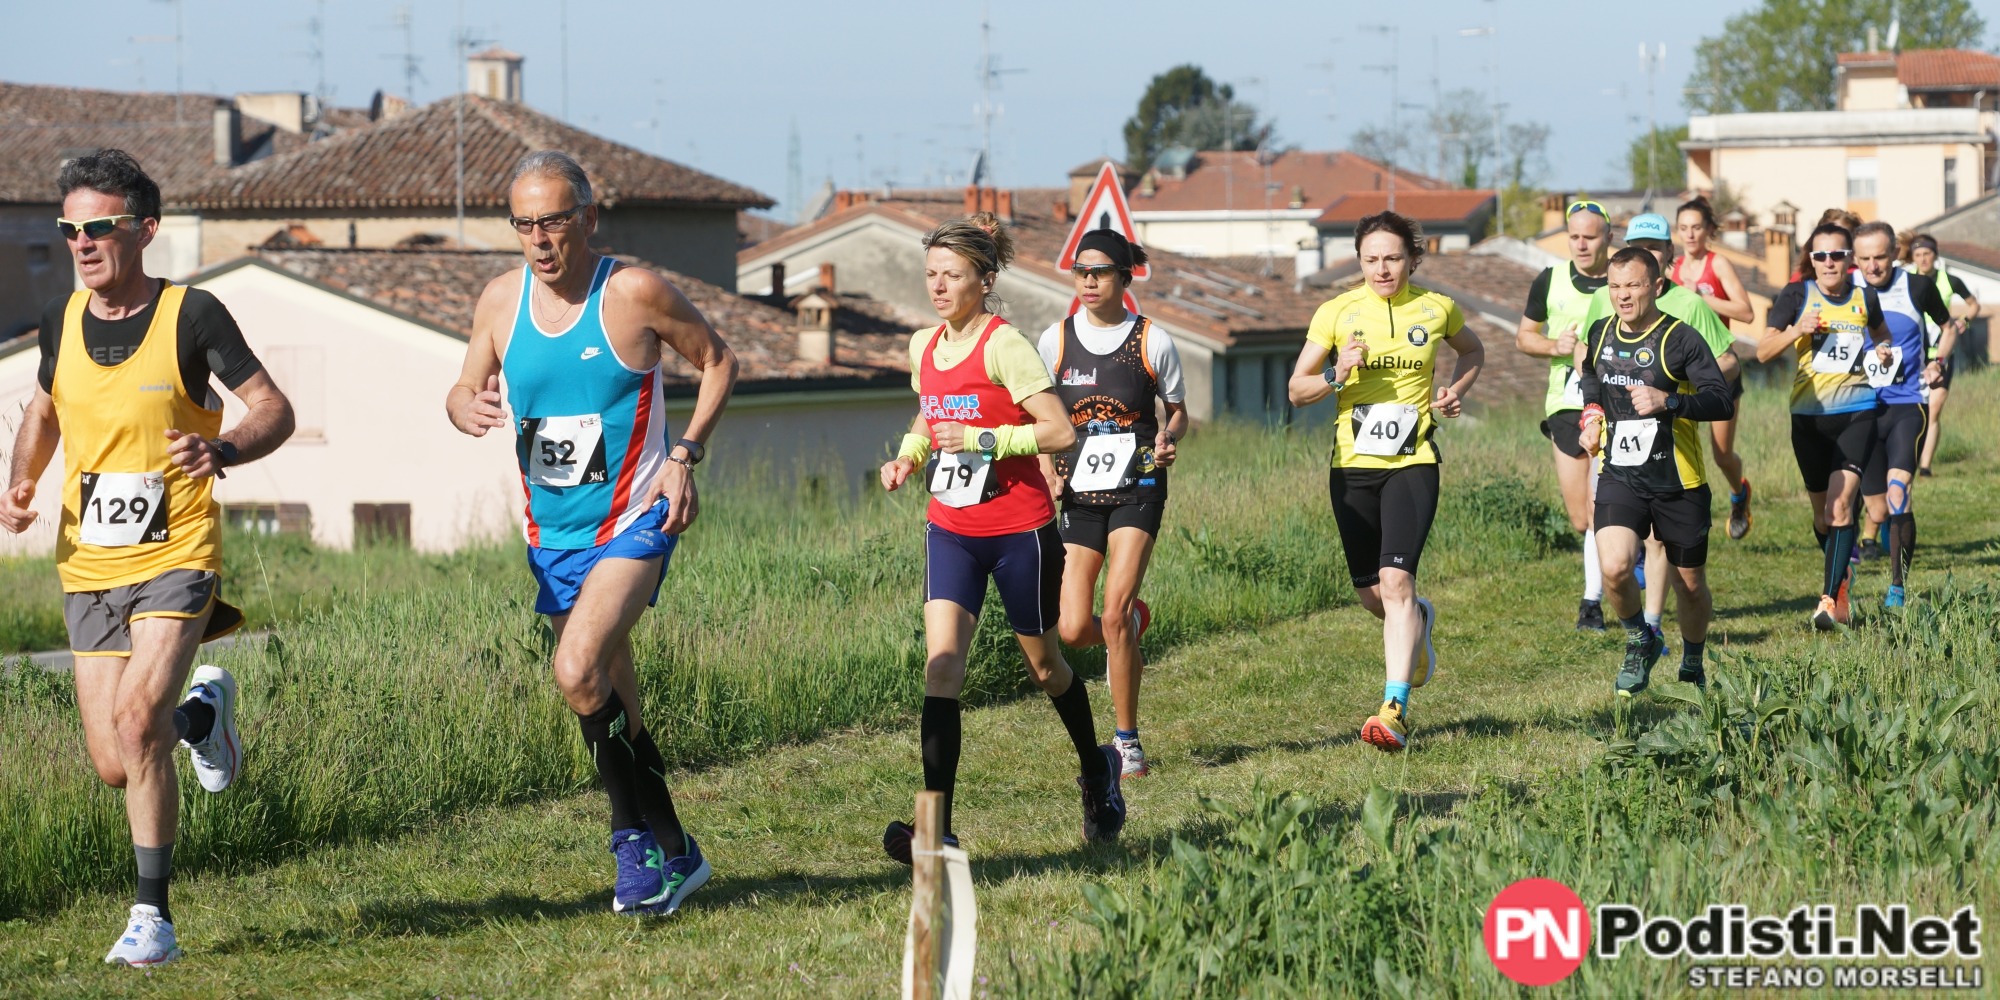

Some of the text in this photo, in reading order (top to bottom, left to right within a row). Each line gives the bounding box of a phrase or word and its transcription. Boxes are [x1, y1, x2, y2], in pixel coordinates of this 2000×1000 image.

[1635, 222, 1660, 231] HOKA
[1828, 346, 1849, 361] 45
[1358, 355, 1423, 371] AdBlue
[1602, 373, 1645, 386] AdBlue
[943, 394, 980, 409] AVIS
[1073, 395, 1129, 413] MONTECATINI
[1369, 420, 1400, 440] 40
[540, 439, 578, 467] 52
[1619, 435, 1642, 453] 41
[1086, 452, 1116, 474] 99
[941, 464, 973, 490] 79
[91, 496, 150, 525] 129
